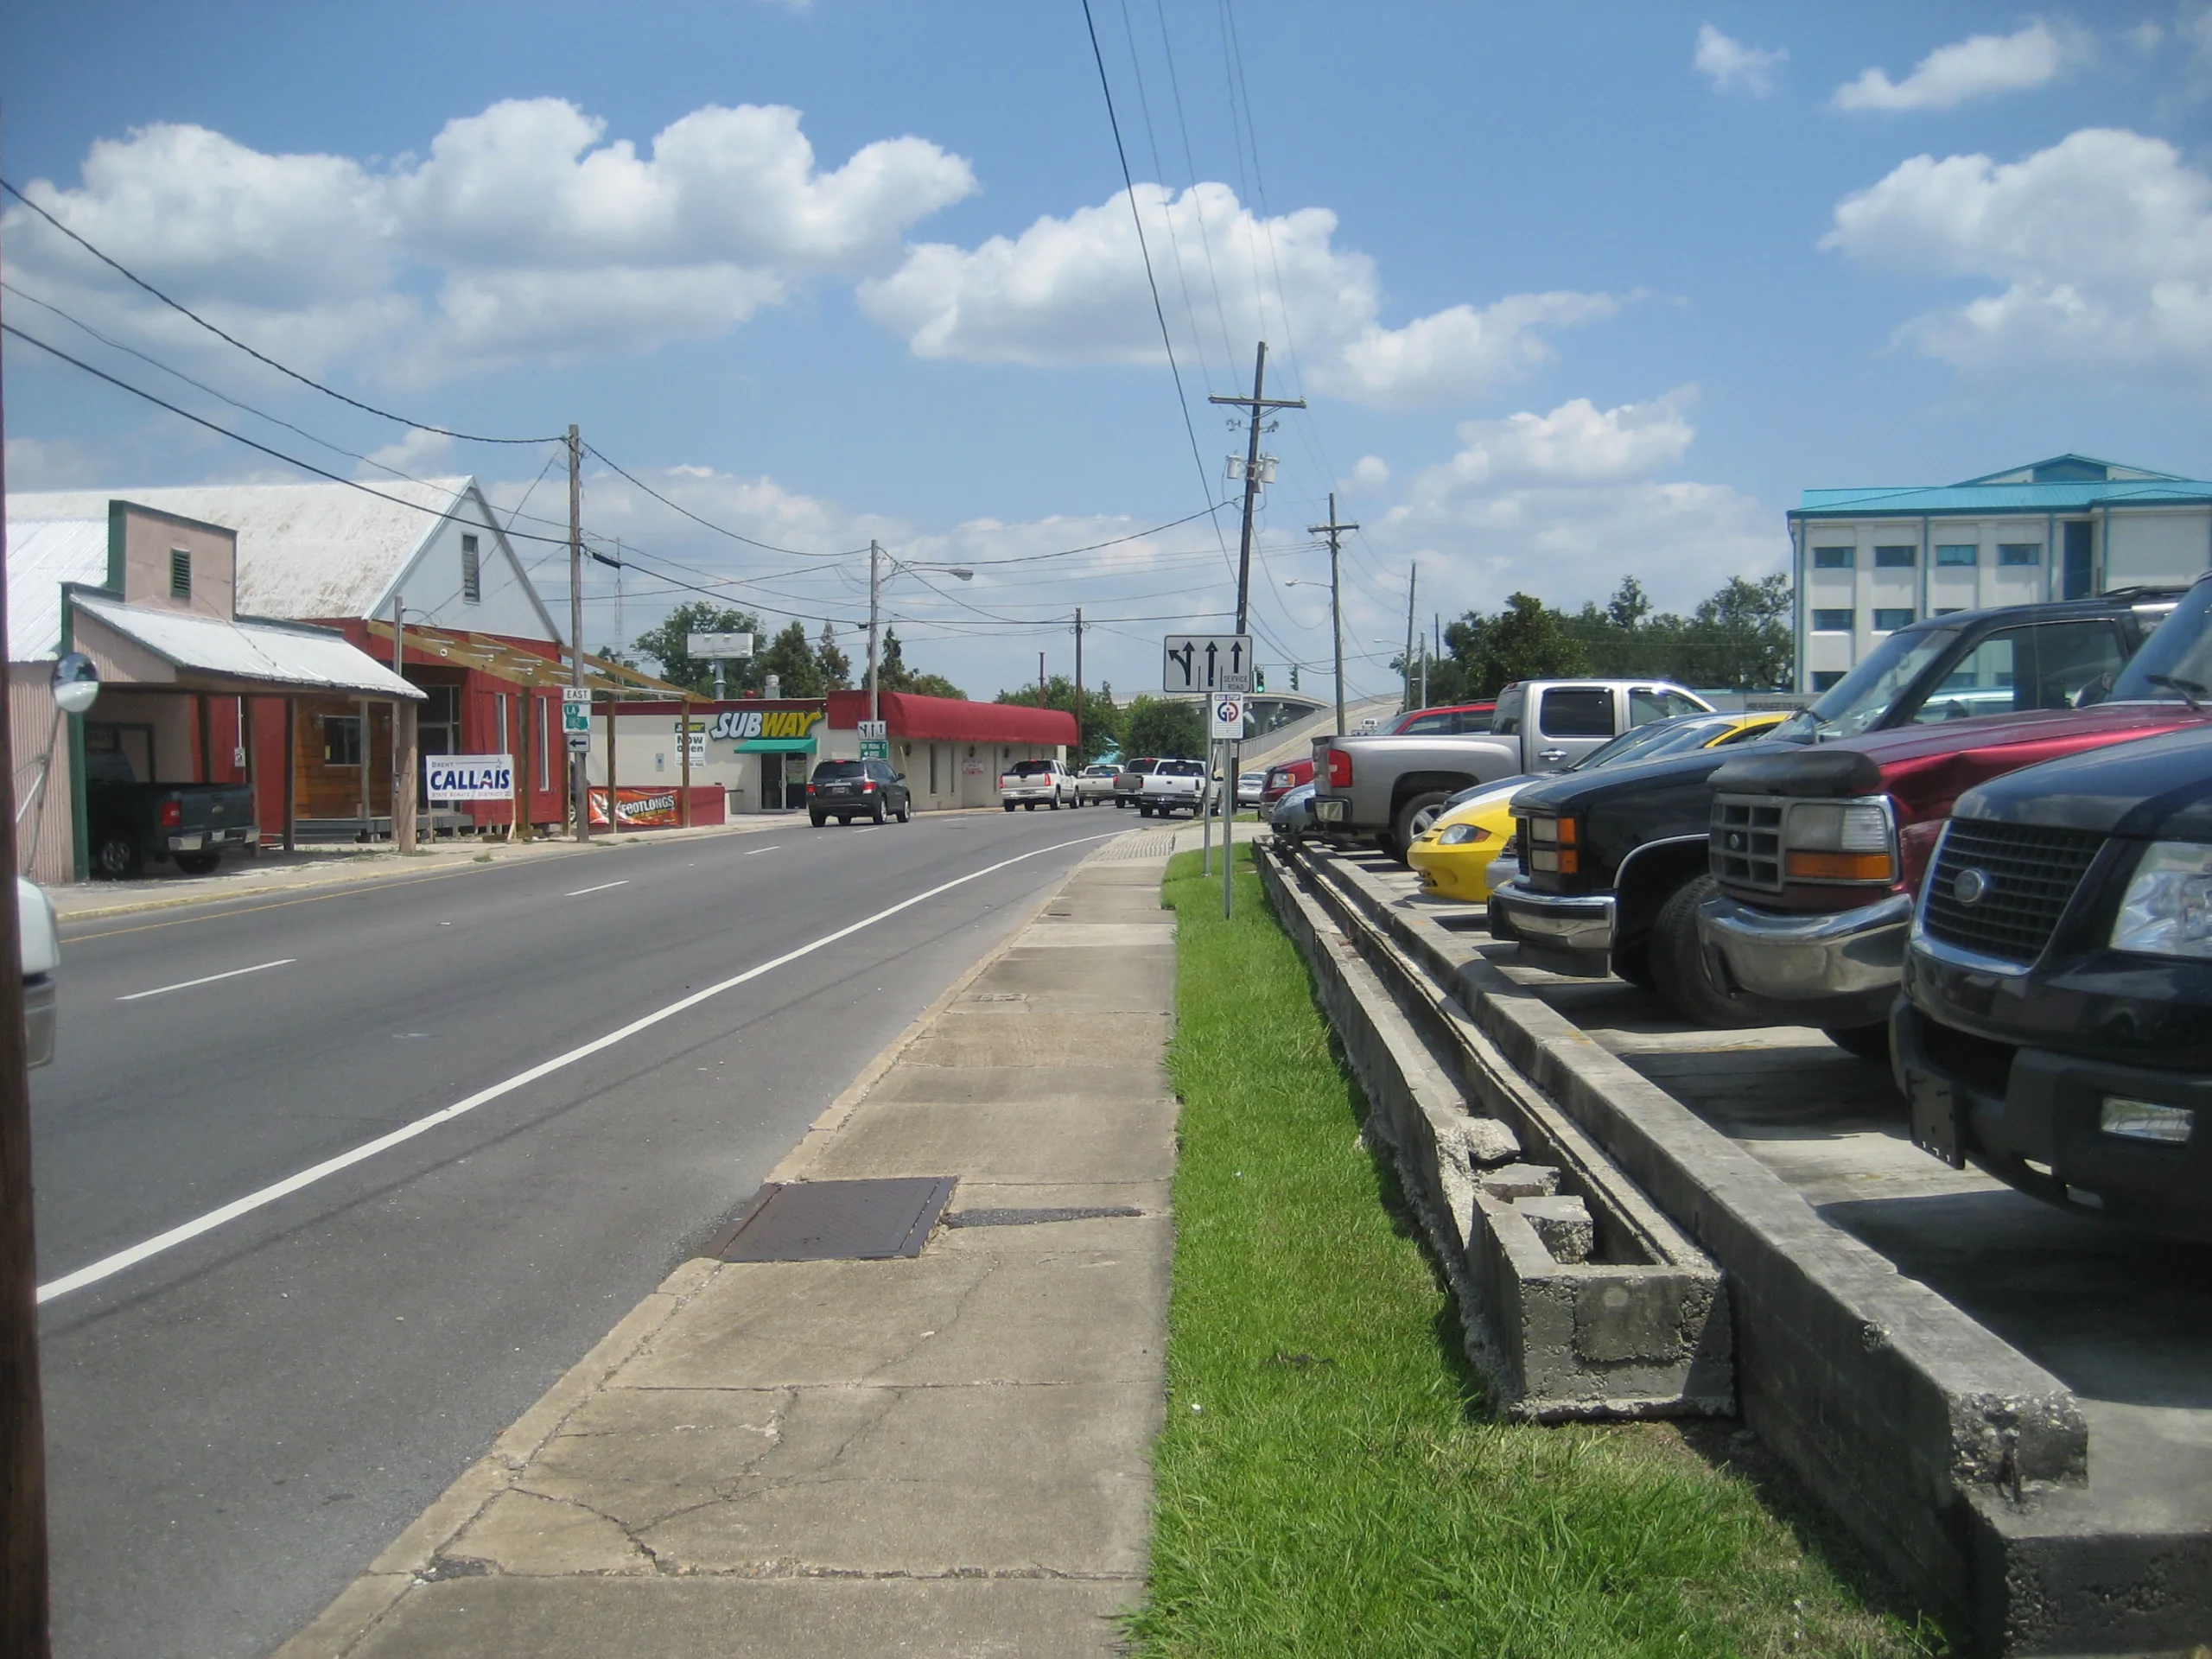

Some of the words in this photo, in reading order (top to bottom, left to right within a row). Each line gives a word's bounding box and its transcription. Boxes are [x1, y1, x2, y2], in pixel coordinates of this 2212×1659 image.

[710, 709, 822, 739] SUBWAY
[430, 770, 510, 790] CALLAIS
[620, 795, 675, 815] FOOTLONGS
